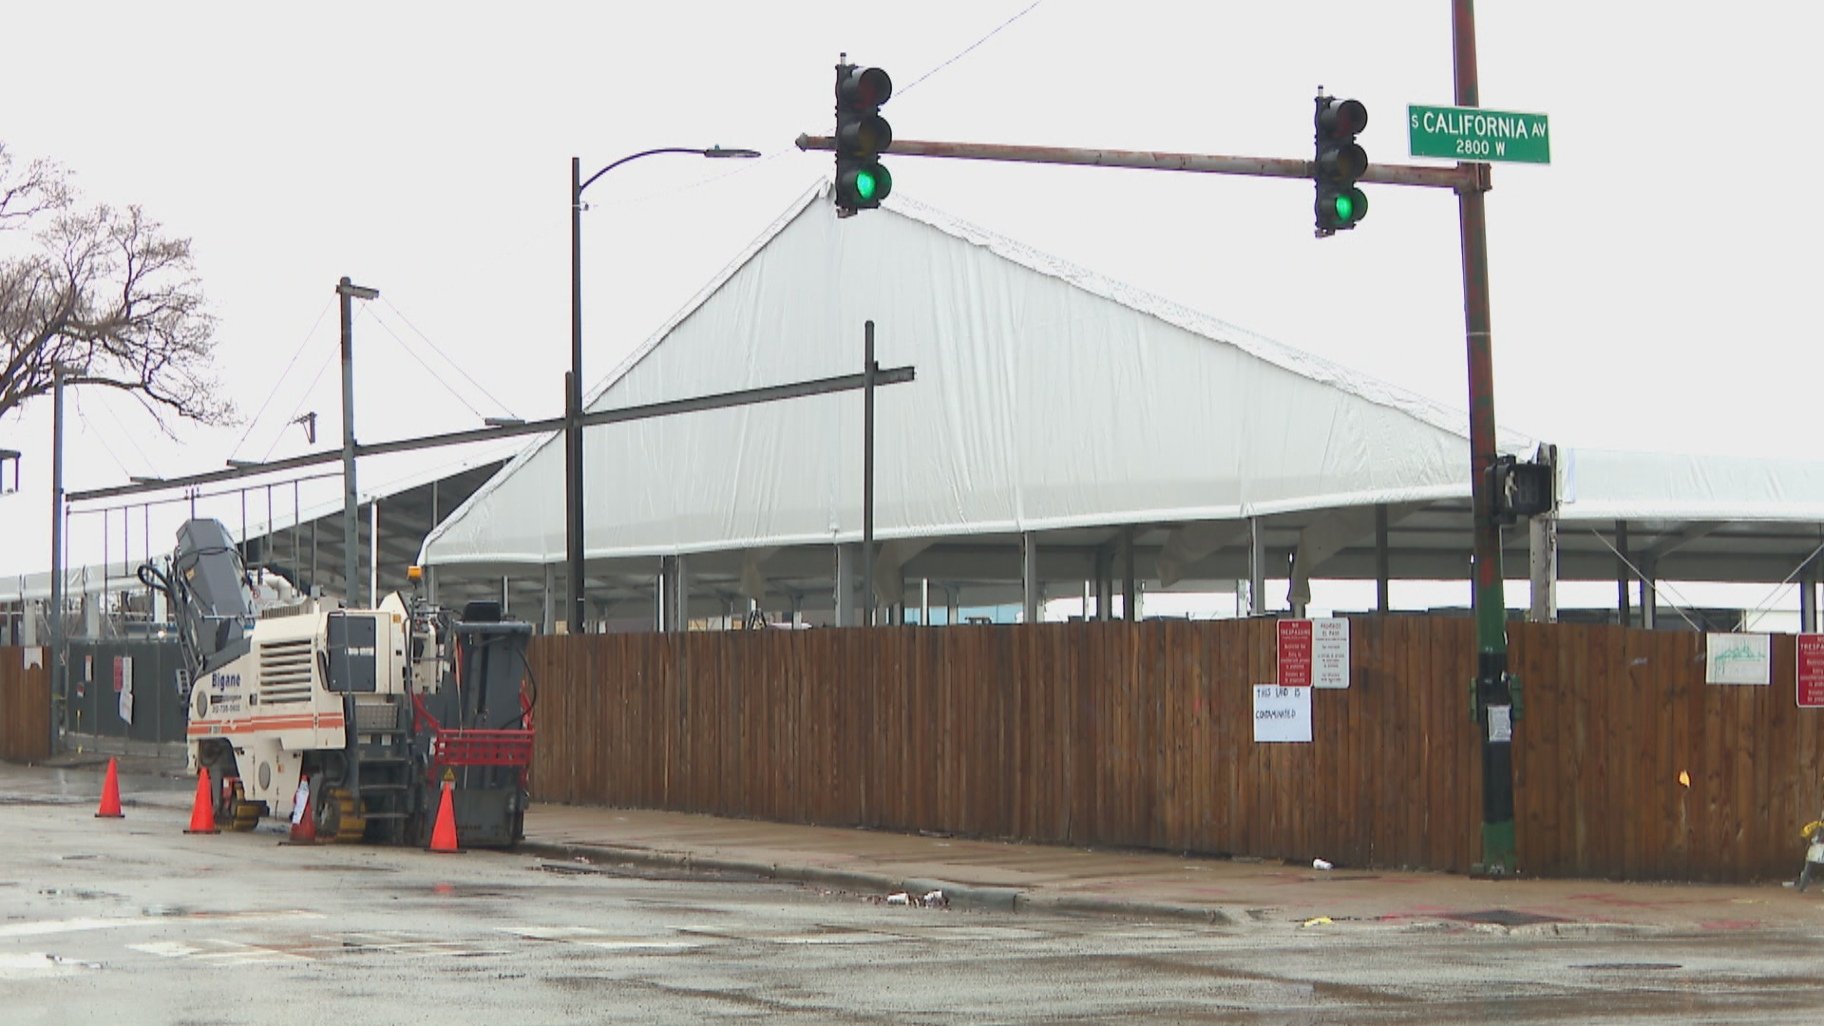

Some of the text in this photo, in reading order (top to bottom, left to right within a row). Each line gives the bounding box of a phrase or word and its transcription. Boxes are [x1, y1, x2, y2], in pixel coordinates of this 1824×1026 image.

[1411, 111, 1546, 139] S CALIFORNIA AV
[1456, 139, 1506, 156] 2800 W
[212, 672, 241, 691] Bigane
